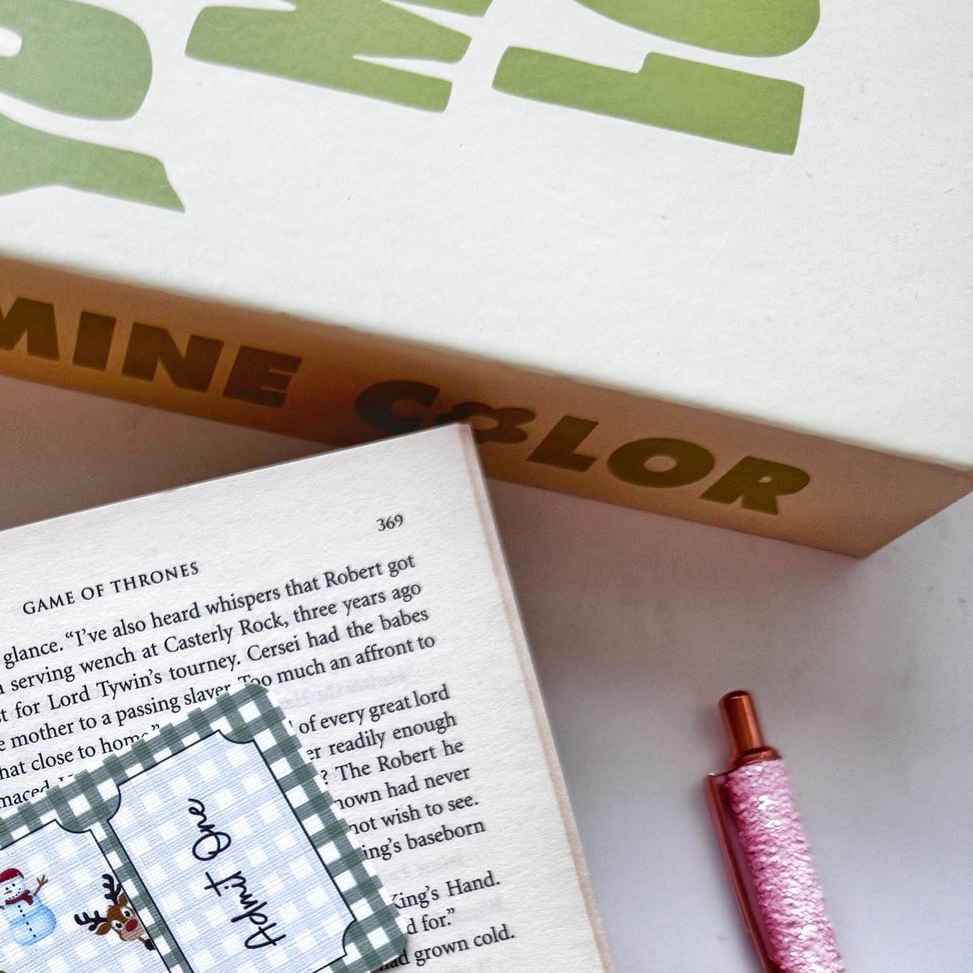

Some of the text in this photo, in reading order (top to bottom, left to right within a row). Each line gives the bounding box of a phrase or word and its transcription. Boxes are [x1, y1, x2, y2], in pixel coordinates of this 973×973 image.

[376, 513, 404, 532] 369
[22, 560, 199, 615] GAME OF THRONES
[3, 640, 64, 670] glance.
[112, 617, 147, 638] also
[149, 600, 202, 629] heard
[203, 587, 281, 615] whispers
[284, 576, 321, 597] that
[322, 561, 384, 588] Robert
[387, 554, 416, 578] got
[404, 820, 487, 850] baseborn
[188, 798, 286, 949] Admit One
[445, 869, 501, 897] Hand.
[413, 922, 516, 967] grown cold.
